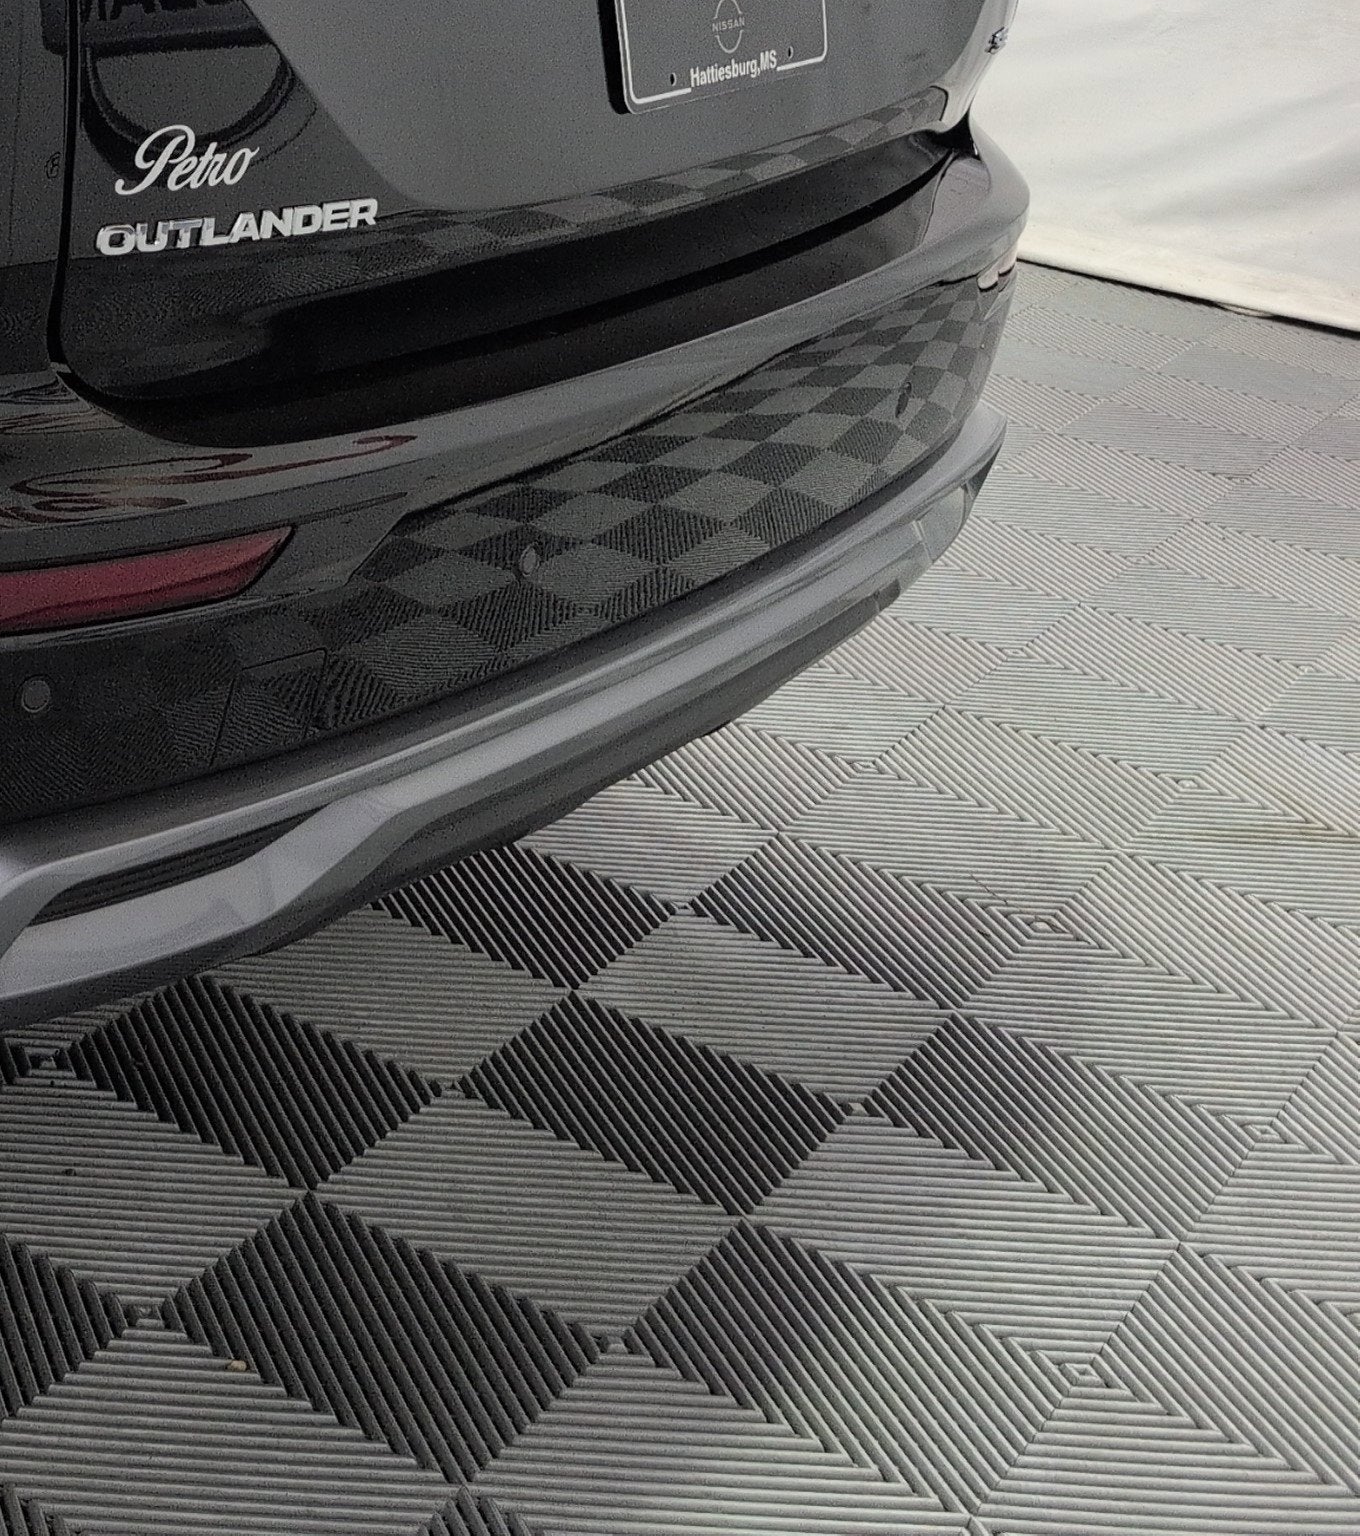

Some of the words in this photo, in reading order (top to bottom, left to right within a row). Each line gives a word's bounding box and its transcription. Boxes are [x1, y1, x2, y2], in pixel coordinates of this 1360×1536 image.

[711, 16, 746, 33] NISSAN
[689, 48, 778, 89] Hattiesburg,MS
[114, 124, 260, 196] Petro
[96, 197, 379, 256] OUTLANDER
